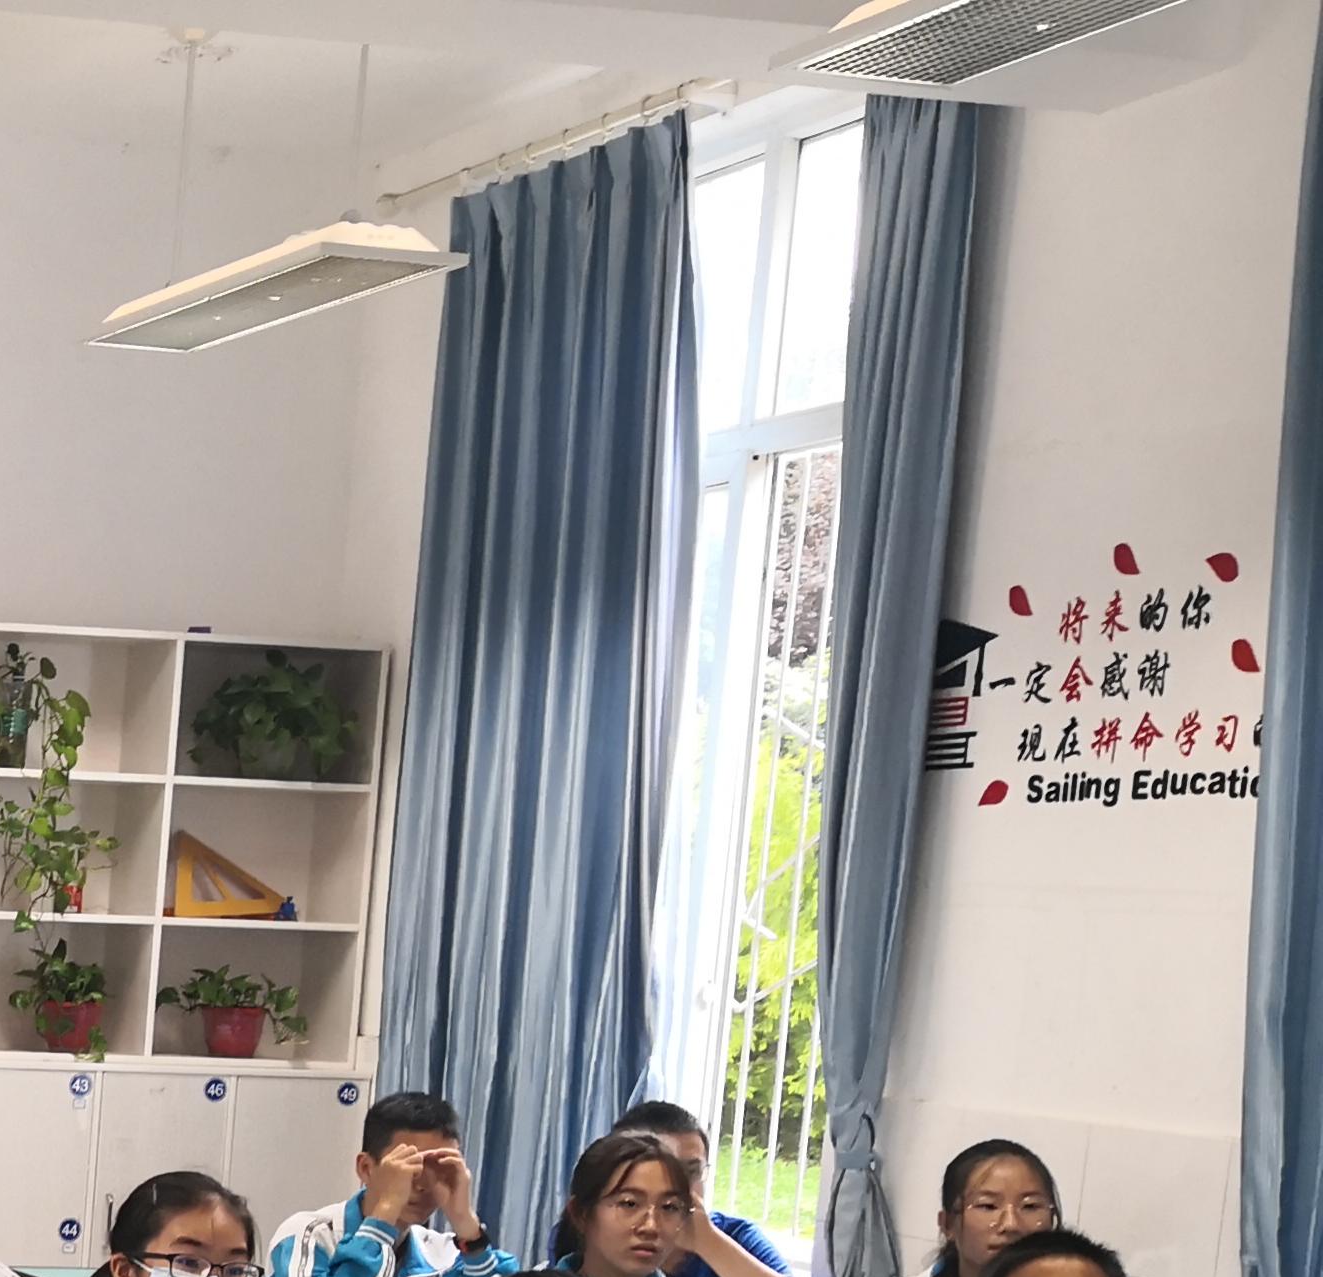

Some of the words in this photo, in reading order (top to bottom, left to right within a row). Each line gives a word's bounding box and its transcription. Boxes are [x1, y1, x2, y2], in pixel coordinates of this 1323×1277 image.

[1059, 585, 1212, 644] 将来的你
[988, 651, 1171, 704] 一定会感谢
[1027, 770, 1121, 807] Sailing
[71, 1079, 90, 1093] 43
[206, 1083, 225, 1097] 46
[339, 1087, 357, 1101] 49
[61, 1223, 79, 1237] 44
